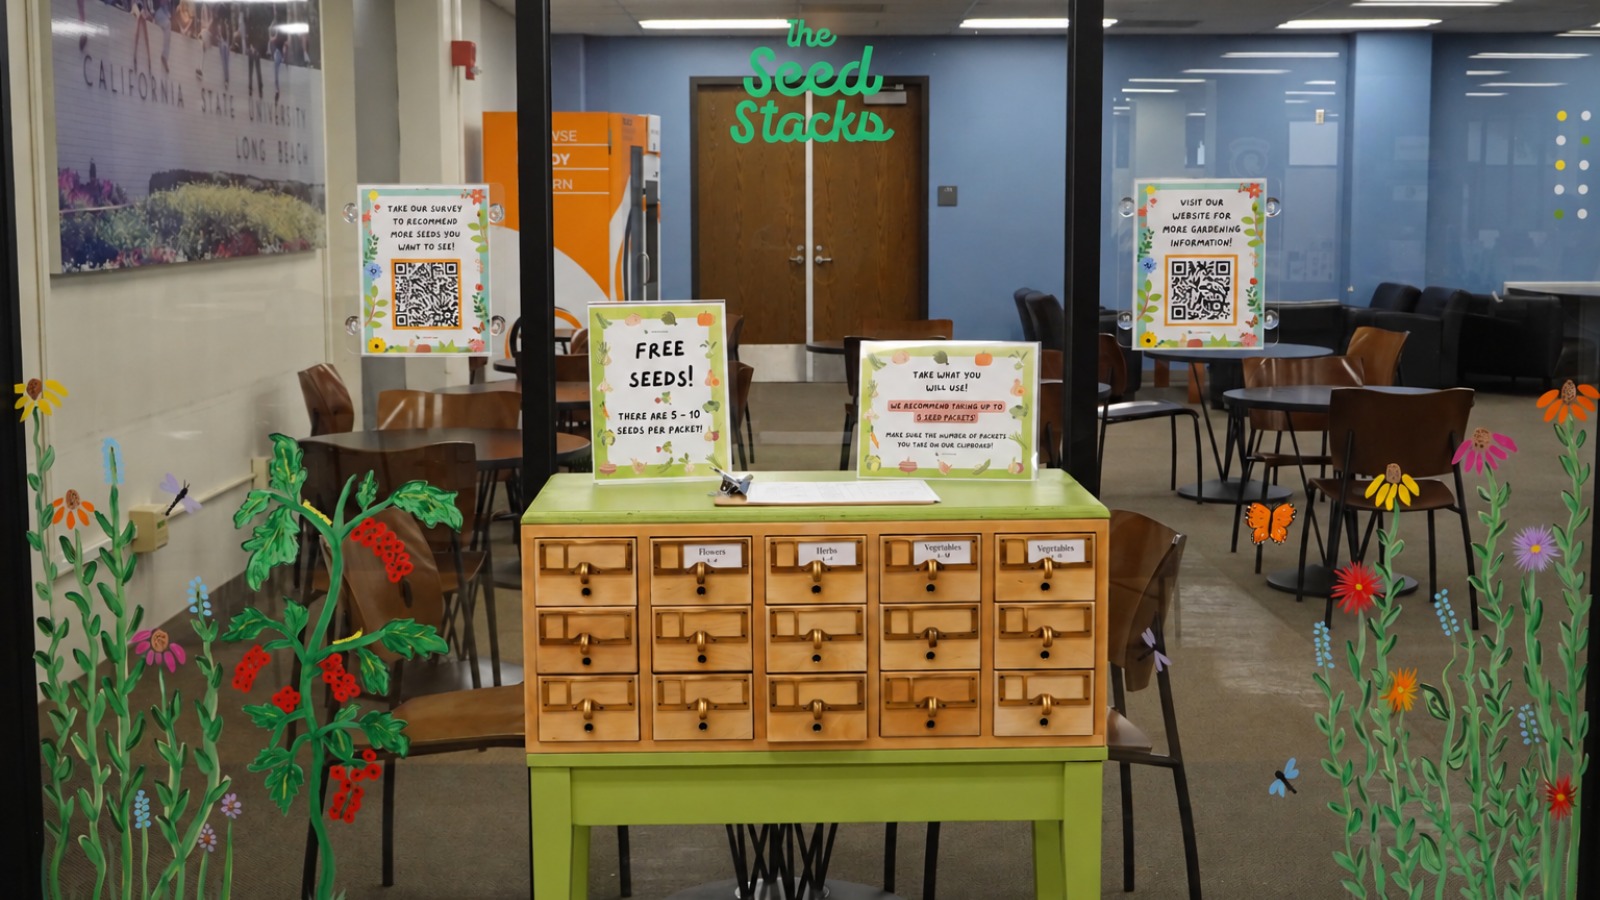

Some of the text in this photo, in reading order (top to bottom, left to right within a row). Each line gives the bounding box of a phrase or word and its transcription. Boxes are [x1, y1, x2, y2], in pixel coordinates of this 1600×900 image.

[787, 19, 837, 47] The
[743, 45, 884, 98] Seed
[83, 54, 307, 129] CALIFORNIA STATE UNIVERSITY
[730, 99, 895, 144] Stacks
[236, 136, 309, 165] LONG BEACH
[1180, 198, 1224, 207] VISIT OUR
[387, 204, 463, 213] TAKE OUR SURVEY
[1172, 211, 1231, 221] WEBSITE FOR
[393, 217, 458, 226] TO RECOMMEND
[1162, 224, 1241, 234] MORE GARDENING
[390, 230, 461, 239] MORE SEEDS YOU
[397, 242, 455, 251] WANT TO SEE!
[1170, 237, 1233, 248] INFORMATION!
[635, 340, 685, 360] FREE
[628, 364, 693, 388] SEEDS!
[912, 370, 981, 380] TAKE WHAT YOU
[925, 383, 968, 392] WILL USE!
[890, 402, 901, 410] WE
[903, 402, 950, 410] RECOMMEND
[980, 403, 991, 411] UP
[993, 403, 1003, 411] TO
[618, 412, 647, 421] THERE
[650, 411, 668, 421] ARE
[671, 411, 677, 420] 5
[689, 409, 701, 419] 10
[924, 413, 943, 421] SEED
[617, 424, 703, 435] SEEDS PER PACKET!
[885, 431, 903, 439] MAKE
[698, 547, 727, 556] Flowers
[816, 546, 838, 555] Herbs
[924, 543, 962, 554] Vegetables
[1037, 544, 1075, 554] Vegetables
